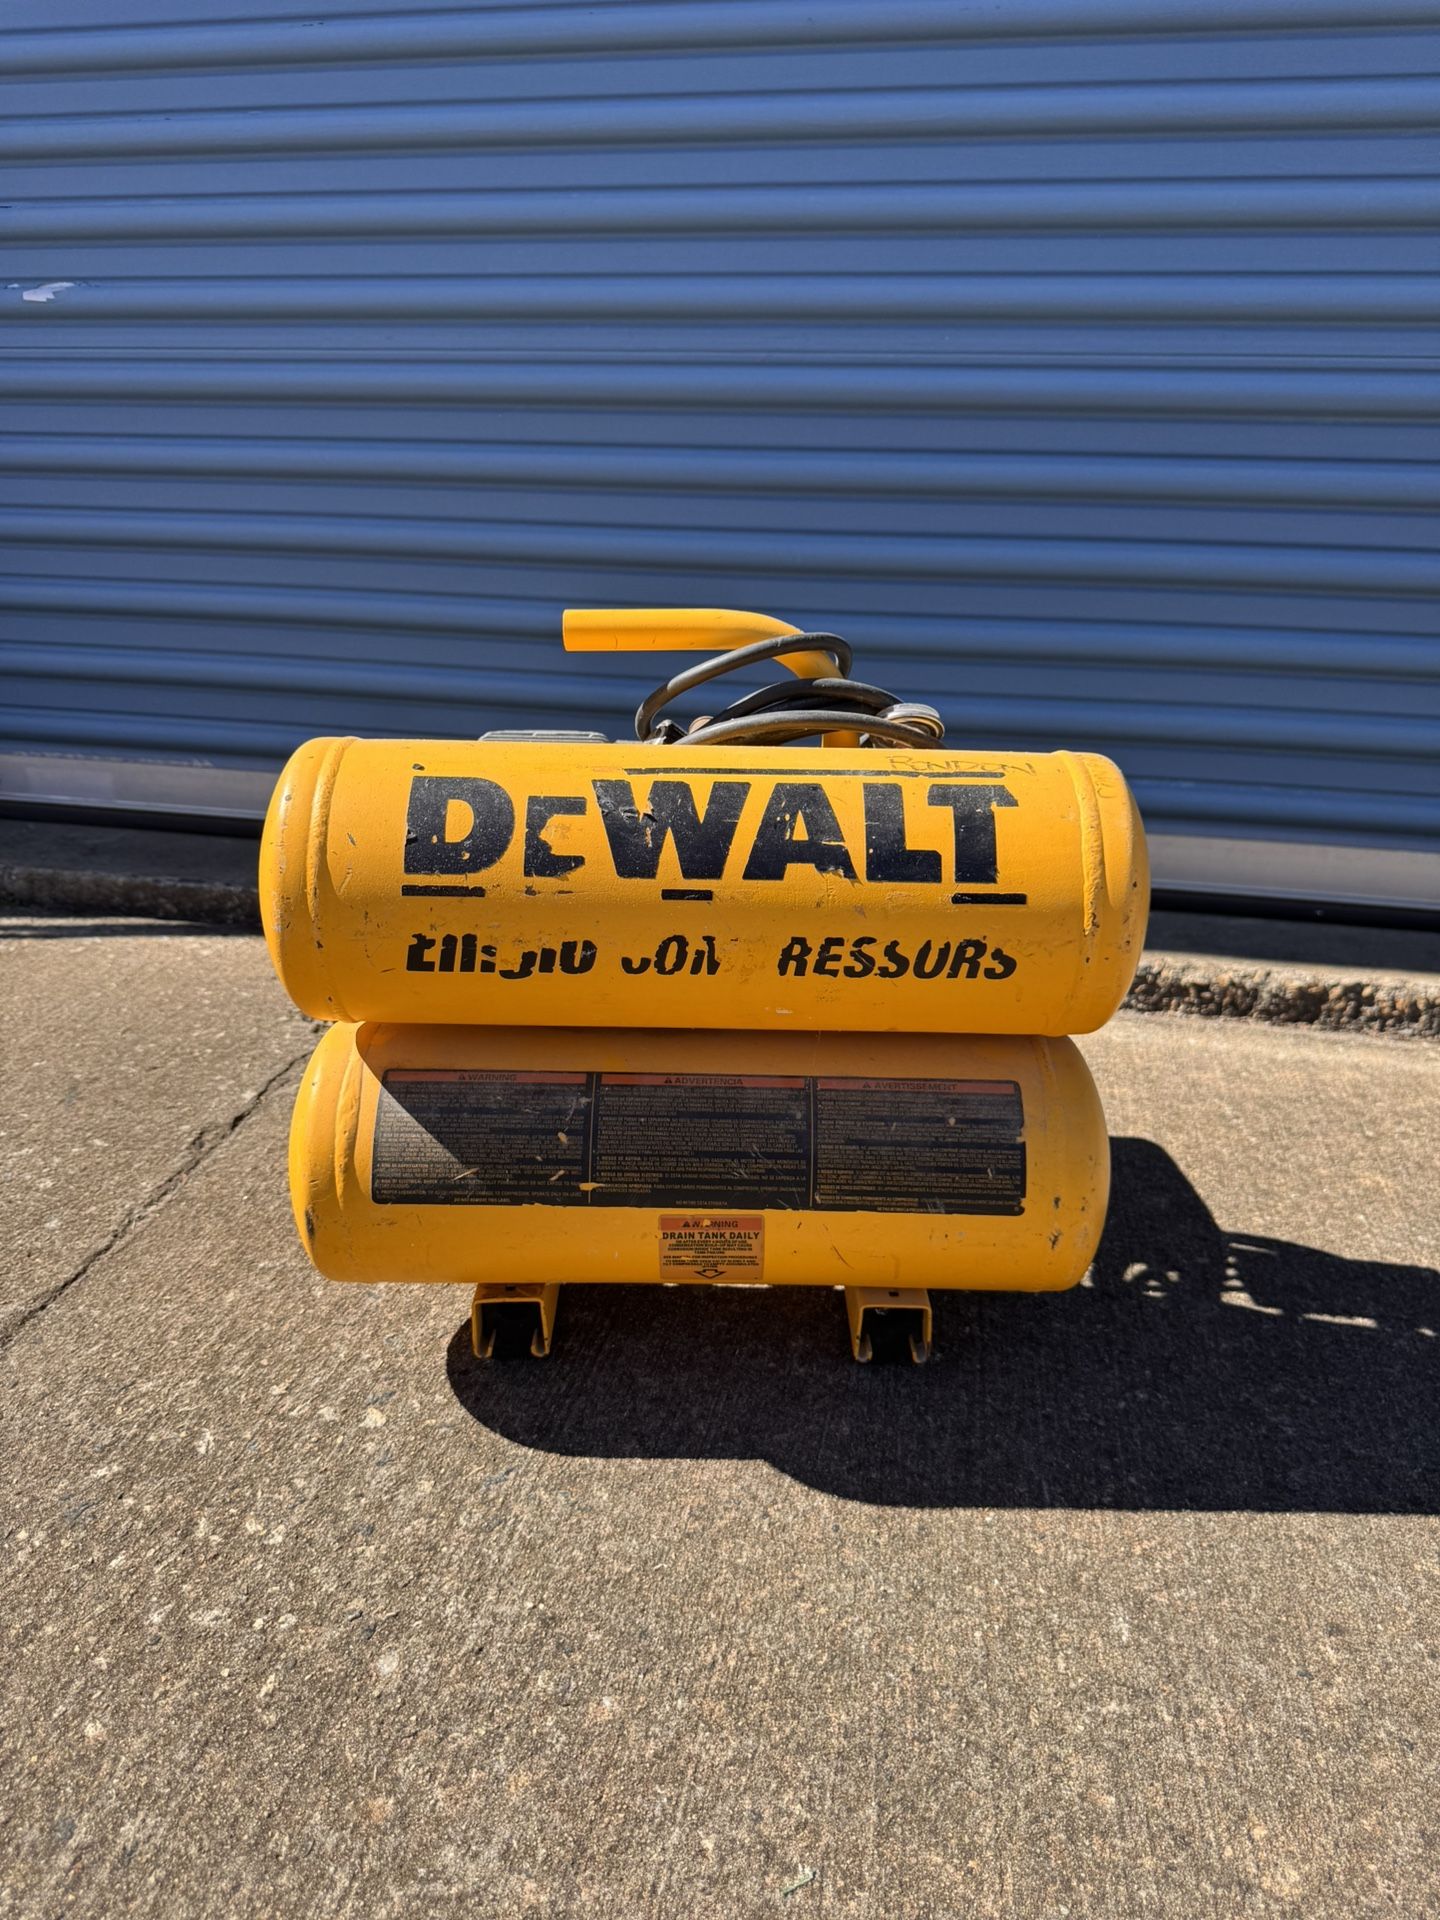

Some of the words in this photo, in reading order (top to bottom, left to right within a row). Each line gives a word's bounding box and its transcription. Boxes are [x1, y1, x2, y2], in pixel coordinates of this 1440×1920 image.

[467, 1073, 517, 1082] WARNING
[674, 1076, 743, 1085] ADVERTENCIA
[874, 1081, 958, 1091] AVERTISSEMENT
[691, 1220, 738, 1228] WRNING
[662, 1231, 695, 1240] DRAIN
[698, 1231, 727, 1240] TANK
[729, 1231, 760, 1240] DAILY
